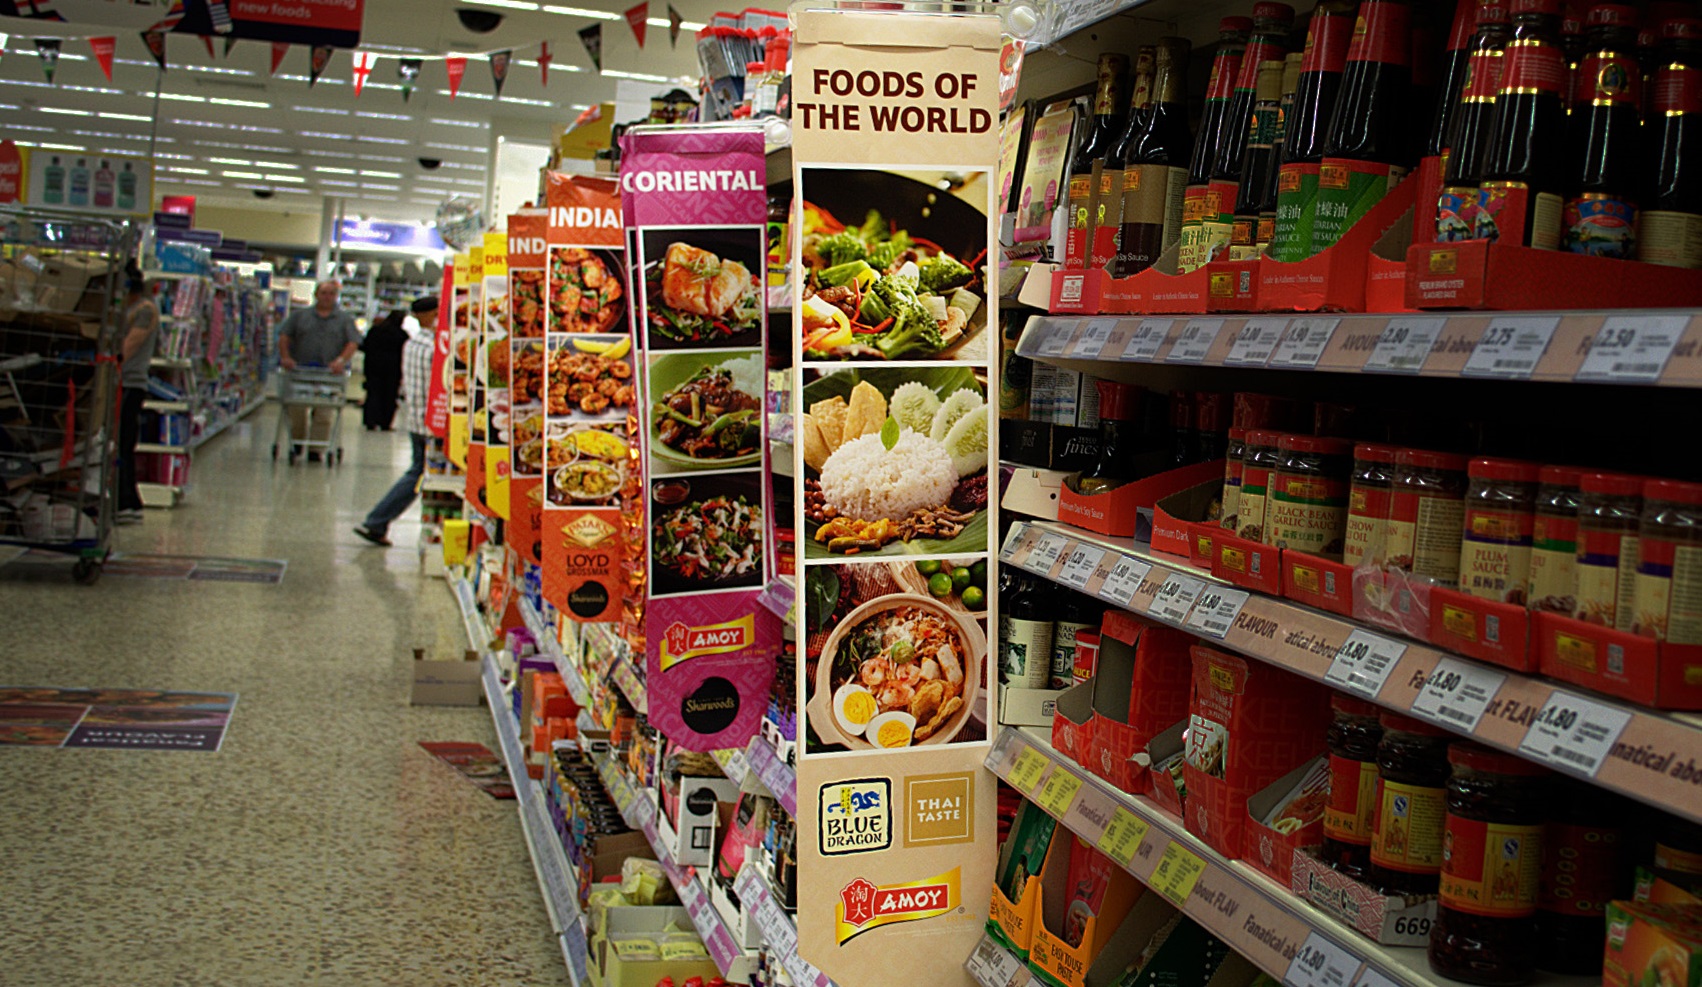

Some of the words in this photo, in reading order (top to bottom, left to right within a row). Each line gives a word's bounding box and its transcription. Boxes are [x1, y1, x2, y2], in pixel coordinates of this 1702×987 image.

[238, 2, 270, 14] new
[271, 3, 312, 18] foods
[813, 68, 925, 98] FOODS
[934, 72, 978, 100] OF
[797, 102, 860, 131] THE
[869, 105, 992, 134] WORLD
[635, 169, 764, 192] ORIENTAL
[550, 206, 624, 229] INDIA
[1127, 252, 1149, 262] Sauce
[1091, 509, 1104, 520] Sauce
[1273, 515, 1305, 528] GARLIC
[1307, 519, 1338, 531] SAUCE
[1277, 505, 1307, 518] BLACK
[1308, 509, 1336, 521] BEAN
[1176, 529, 1189, 541] Dark
[566, 554, 609, 568] LOYD
[1475, 549, 1508, 562] PLUM
[1473, 561, 1510, 576] SAUCE
[693, 630, 741, 647] AMOY
[1234, 611, 1279, 640] FLAVOUR
[1284, 630, 1316, 651] atical
[1339, 640, 1370, 661] £1.80
[1426, 670, 1462, 692] £1.80
[1536, 705, 1578, 731] £1.80
[917, 796, 960, 811] THAI
[827, 814, 883, 836] BLUE
[917, 809, 960, 823] TASTE
[827, 832, 882, 848] DRAGON
[850, 885, 868, 920] 淘大
[879, 888, 942, 913] AMOY
[1243, 914, 1288, 953] Fanatical
[1297, 945, 1326, 971] £1.80
[1057, 962, 1073, 983] PASTE
